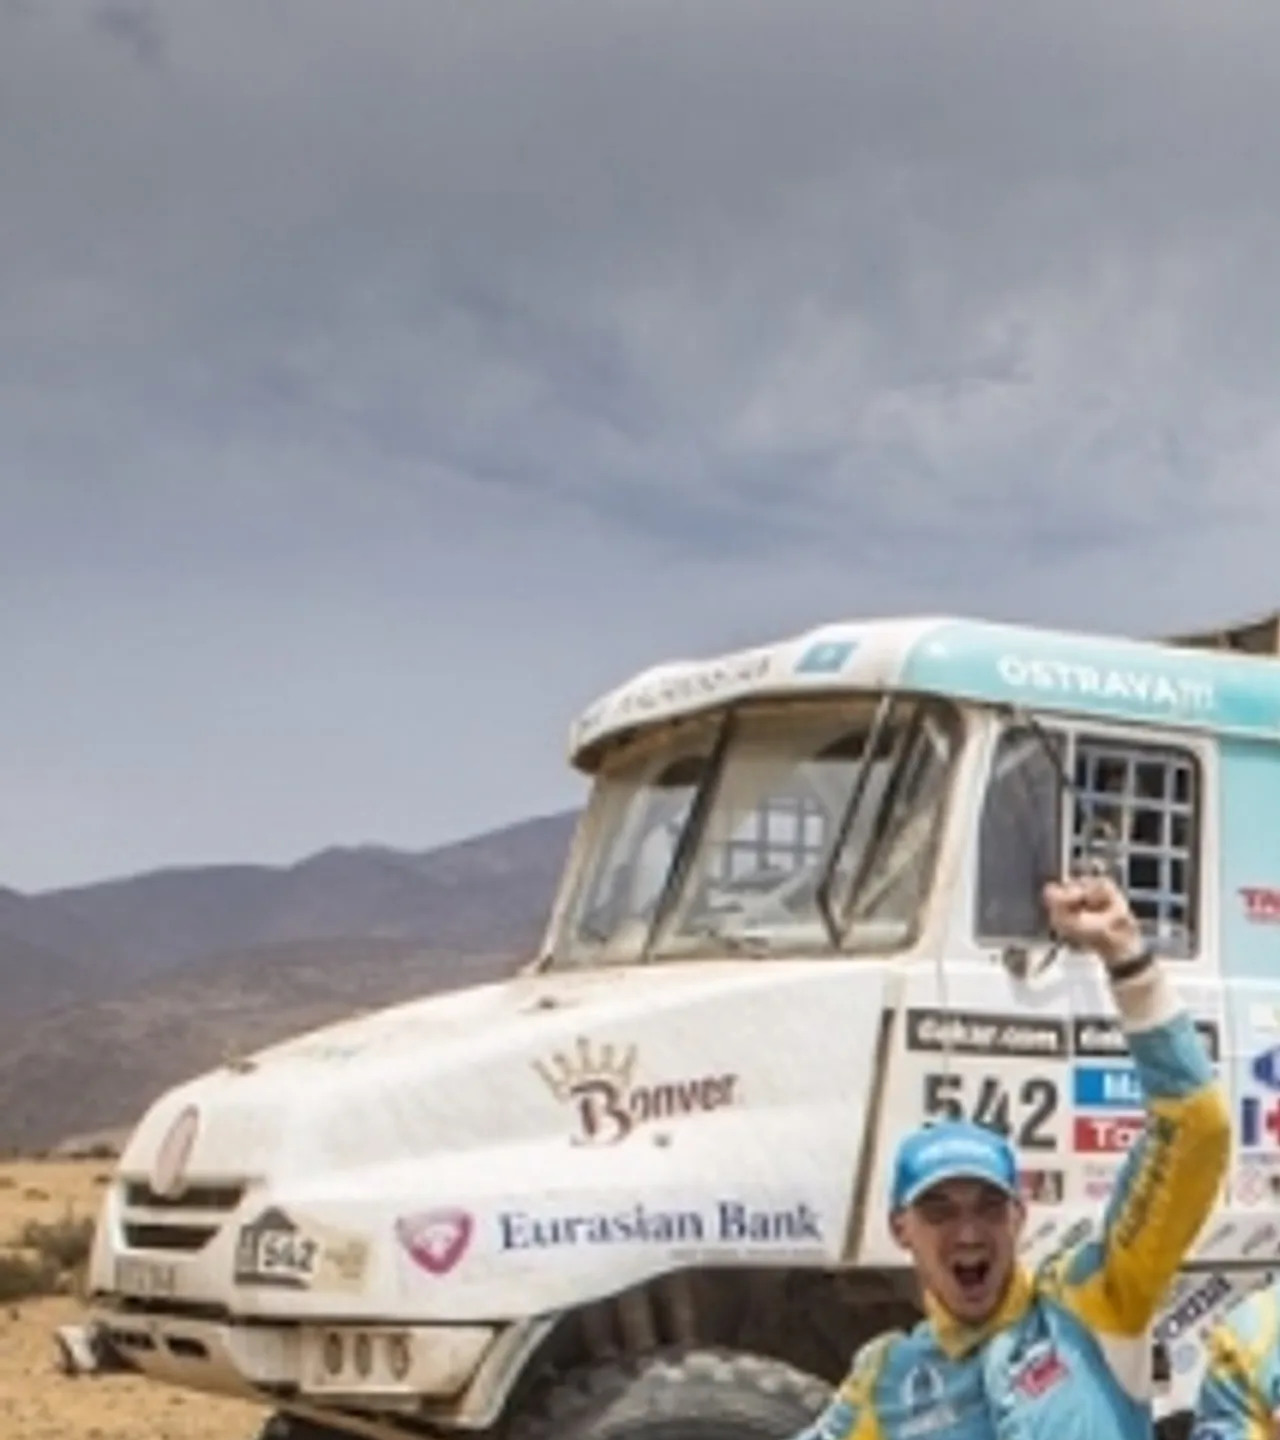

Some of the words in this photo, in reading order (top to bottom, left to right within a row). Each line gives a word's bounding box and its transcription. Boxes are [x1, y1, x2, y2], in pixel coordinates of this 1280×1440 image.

[569, 1073, 739, 1147] Bonver
[923, 1073, 1058, 1149] 542
[498, 1202, 705, 1250] Eurasian
[717, 1199, 823, 1243] Bank
